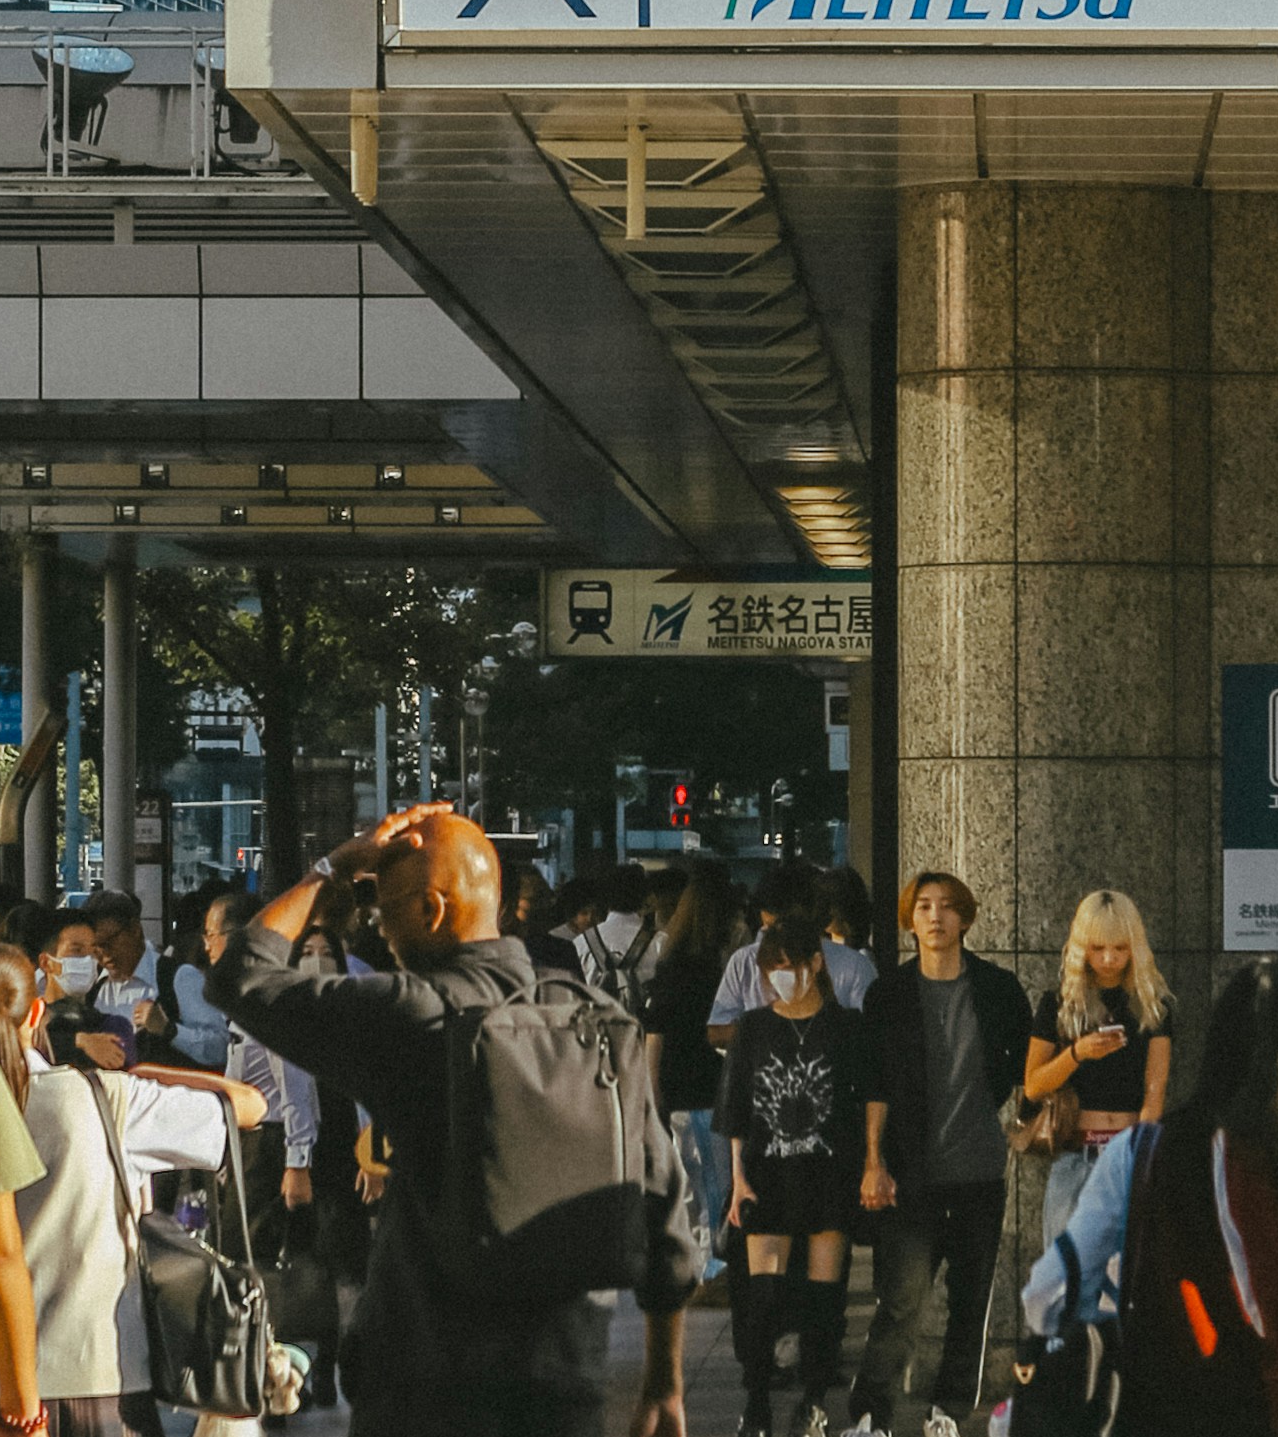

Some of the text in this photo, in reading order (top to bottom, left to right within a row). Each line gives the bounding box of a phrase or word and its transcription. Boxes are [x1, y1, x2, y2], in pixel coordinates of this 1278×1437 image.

[707, 594, 872, 635] 名鉄名古屋
[707, 636, 774, 649] MEITETSU
[778, 636, 834, 649] NAGOYA
